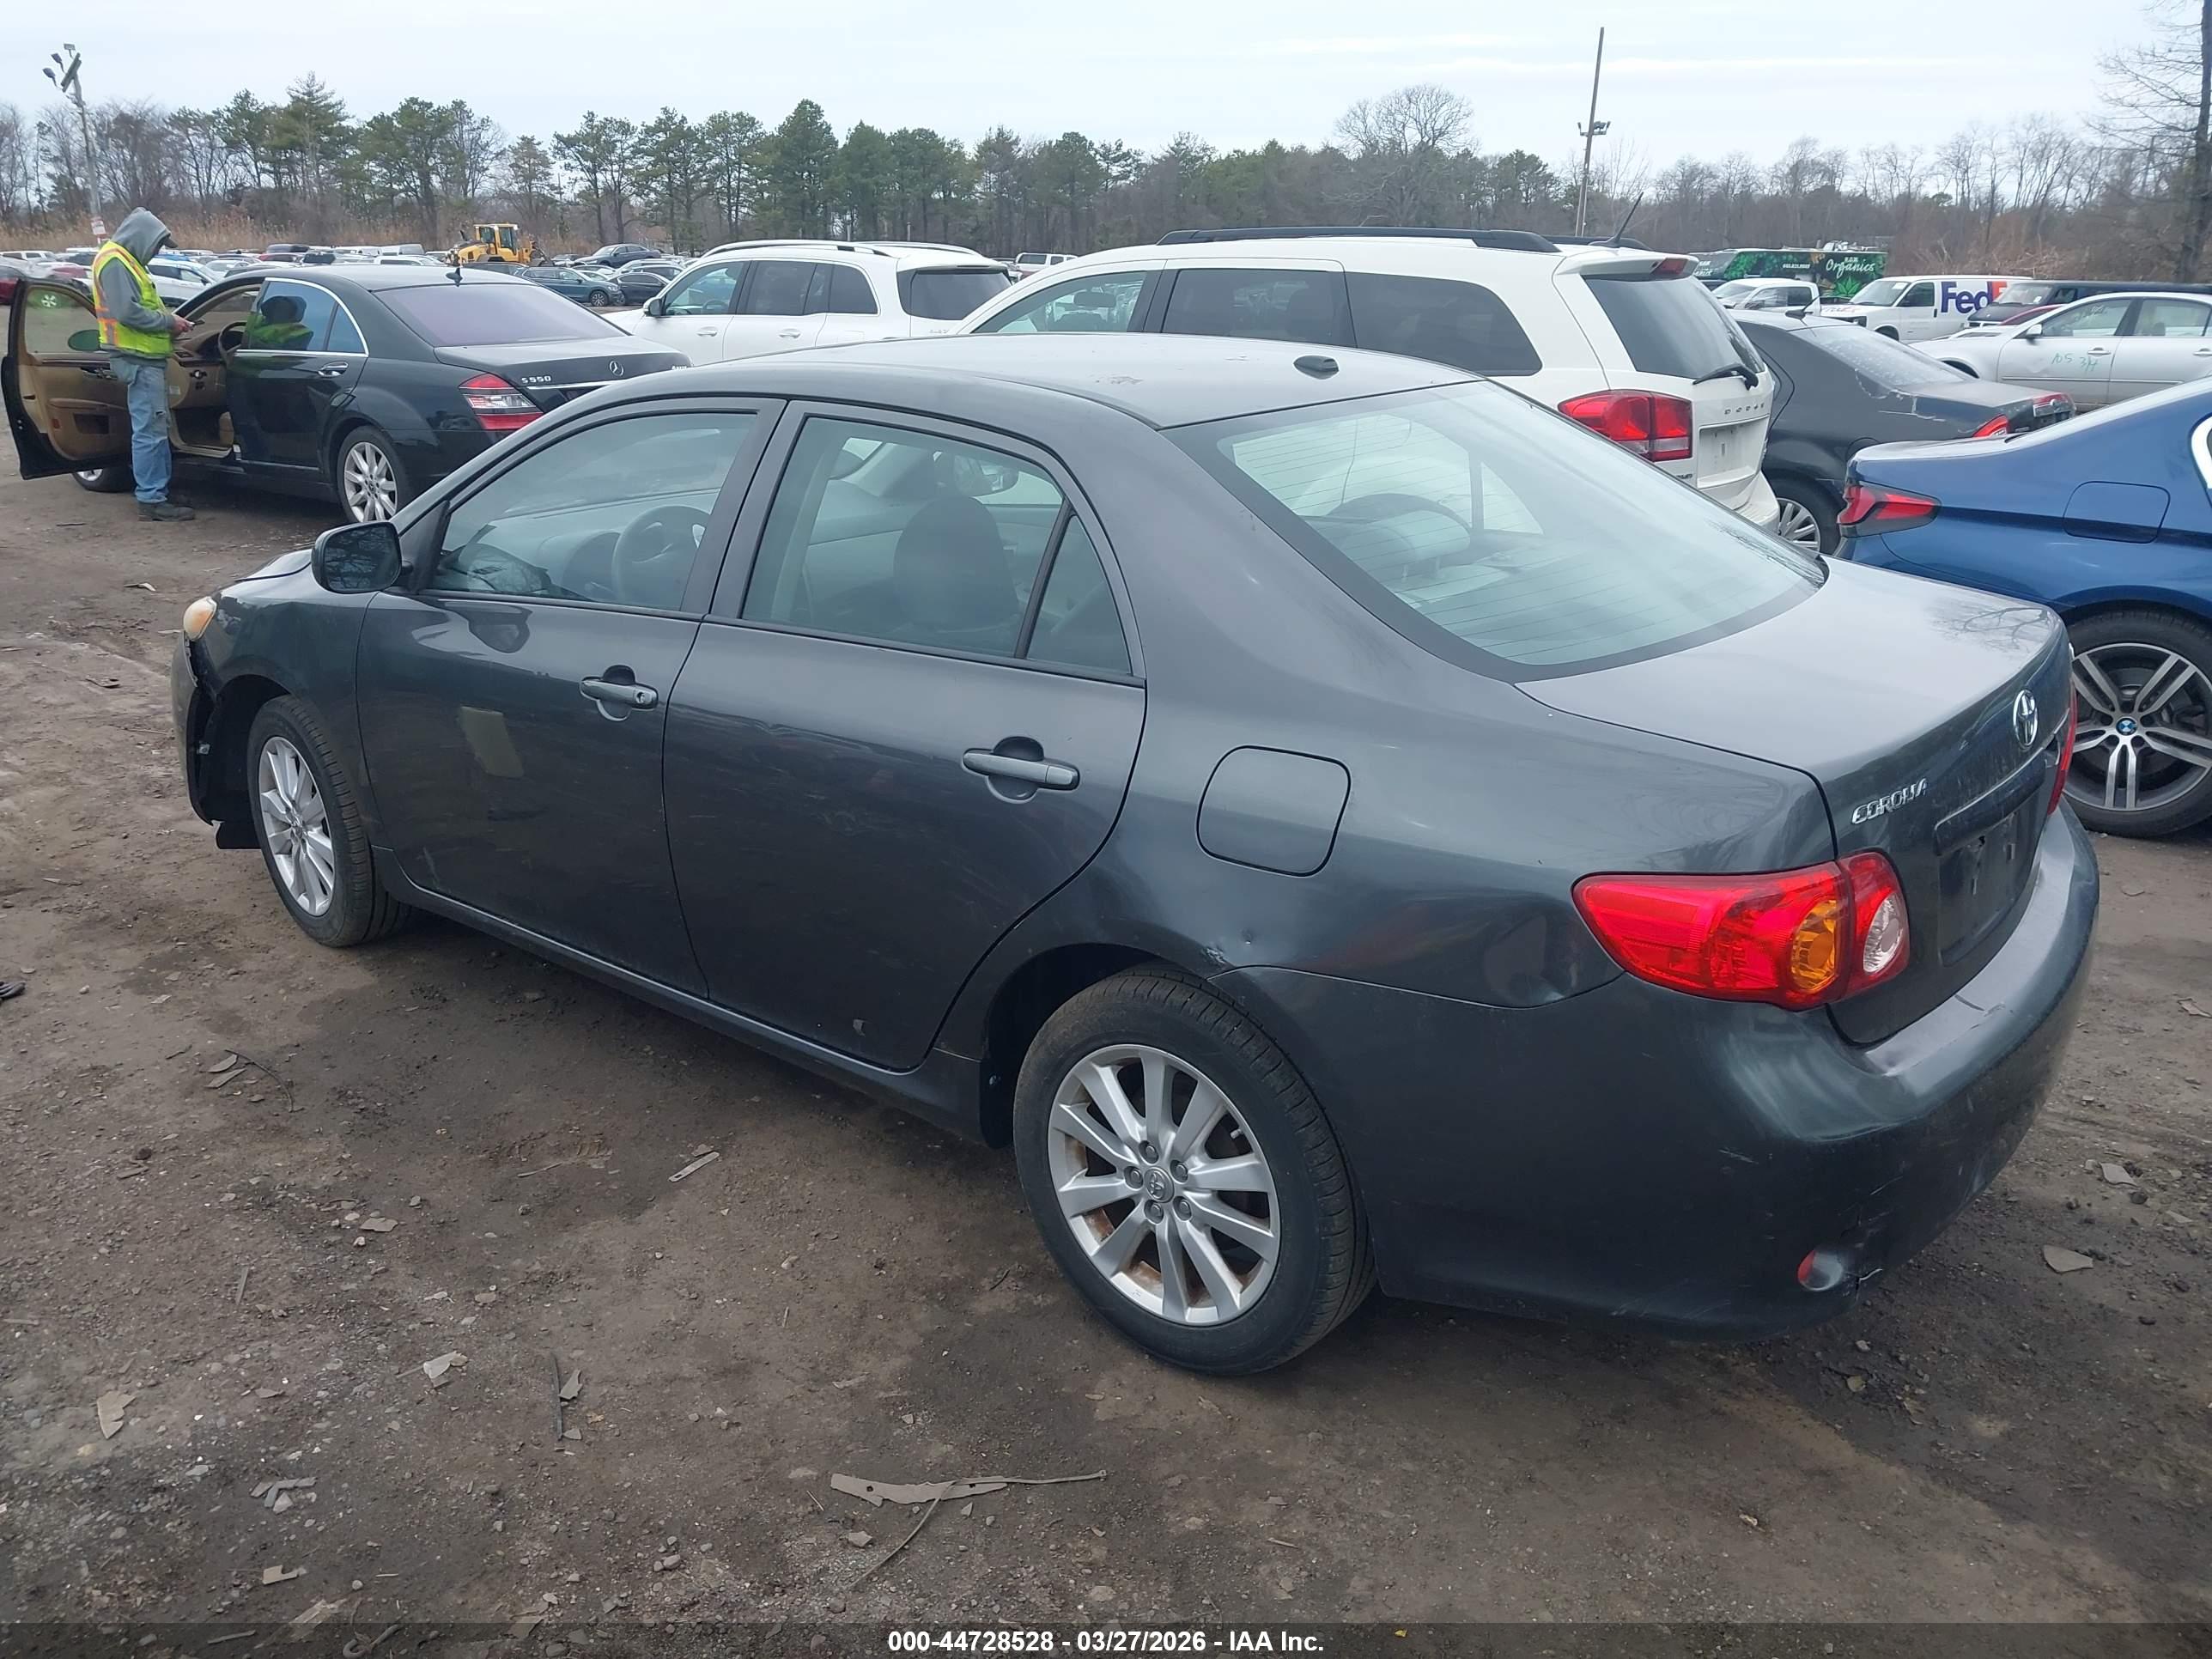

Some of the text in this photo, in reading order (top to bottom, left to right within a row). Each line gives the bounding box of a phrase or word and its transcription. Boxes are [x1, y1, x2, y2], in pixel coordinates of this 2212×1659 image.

[1826, 258, 1875, 278] Organics
[1941, 281, 2008, 314] FedE
[1851, 777, 1927, 824] COROLLA
